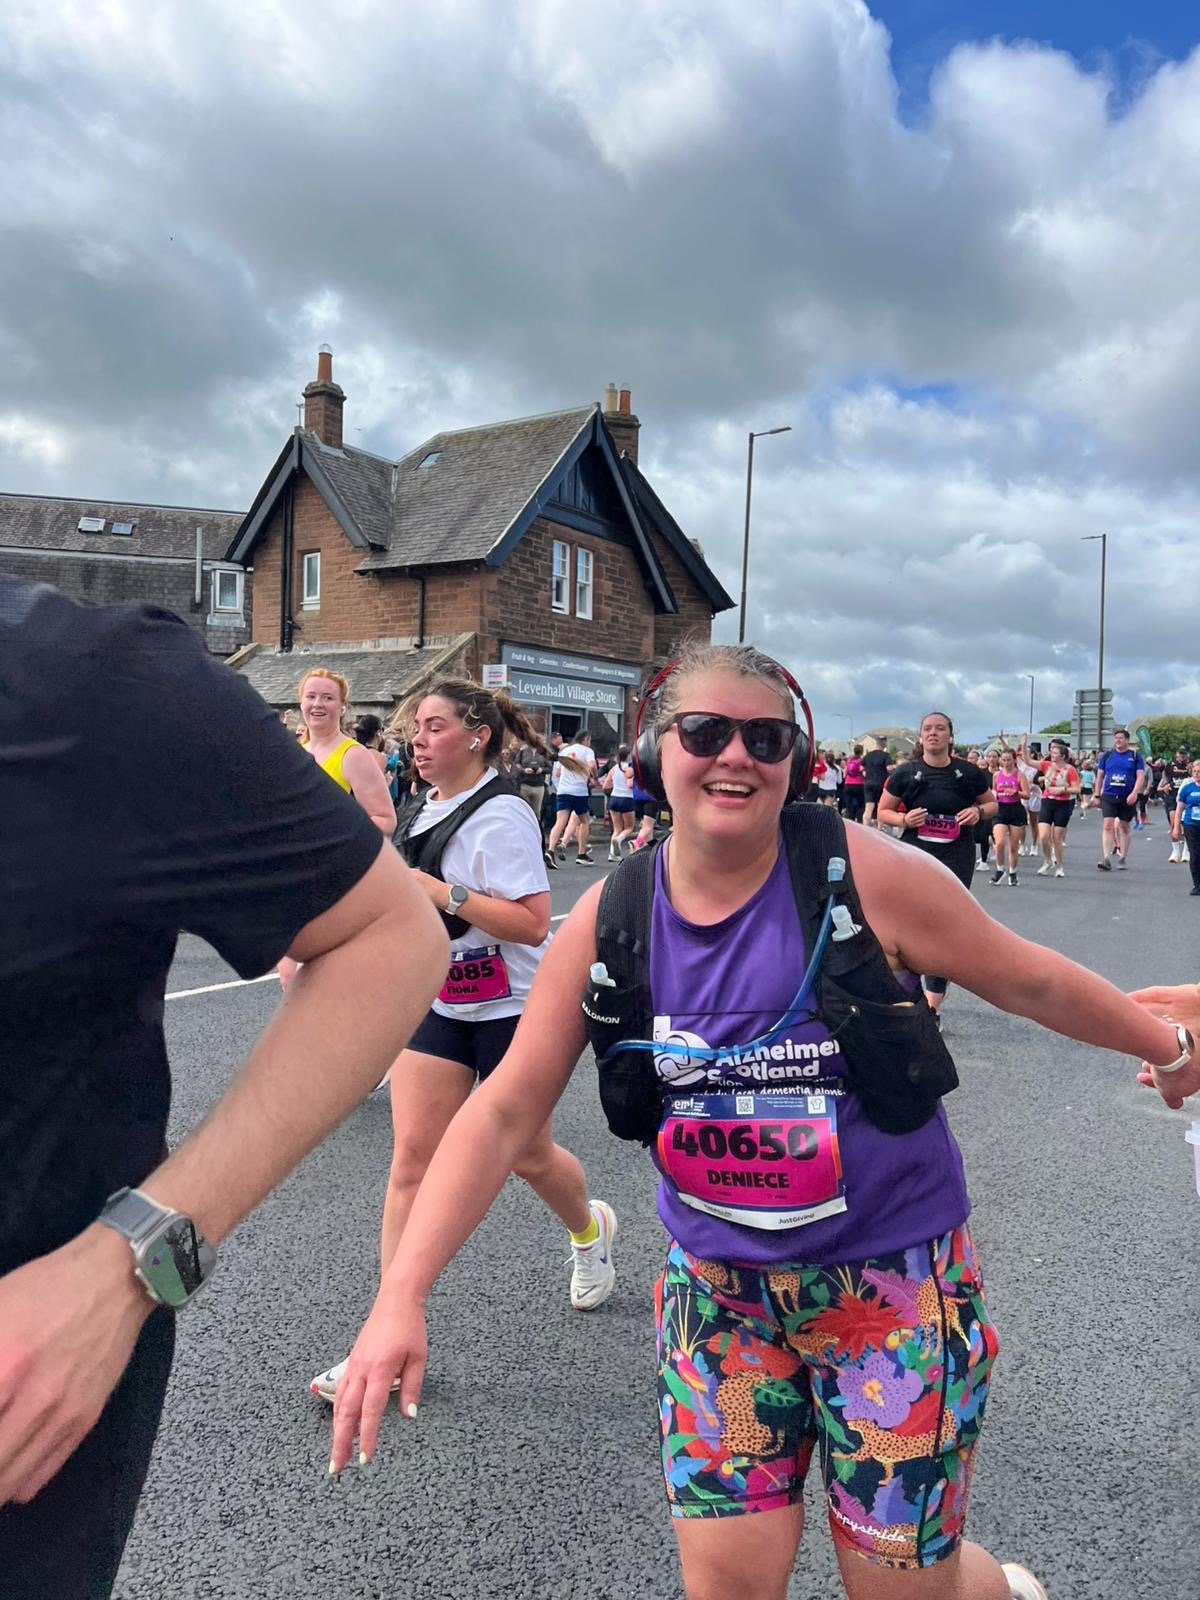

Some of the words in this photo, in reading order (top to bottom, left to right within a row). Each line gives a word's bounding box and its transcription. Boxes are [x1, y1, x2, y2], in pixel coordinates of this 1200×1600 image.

[518, 679, 565, 698] Levenhall
[566, 685, 595, 704] Village
[596, 689, 617, 704] Store
[446, 959, 496, 982] 085
[447, 985, 479, 994] FIONA
[760, 1084, 811, 1096] dementia
[673, 1123, 818, 1161] 40650
[706, 1169, 791, 1189] DENIECE
[777, 1212, 816, 1225] JustGiving
